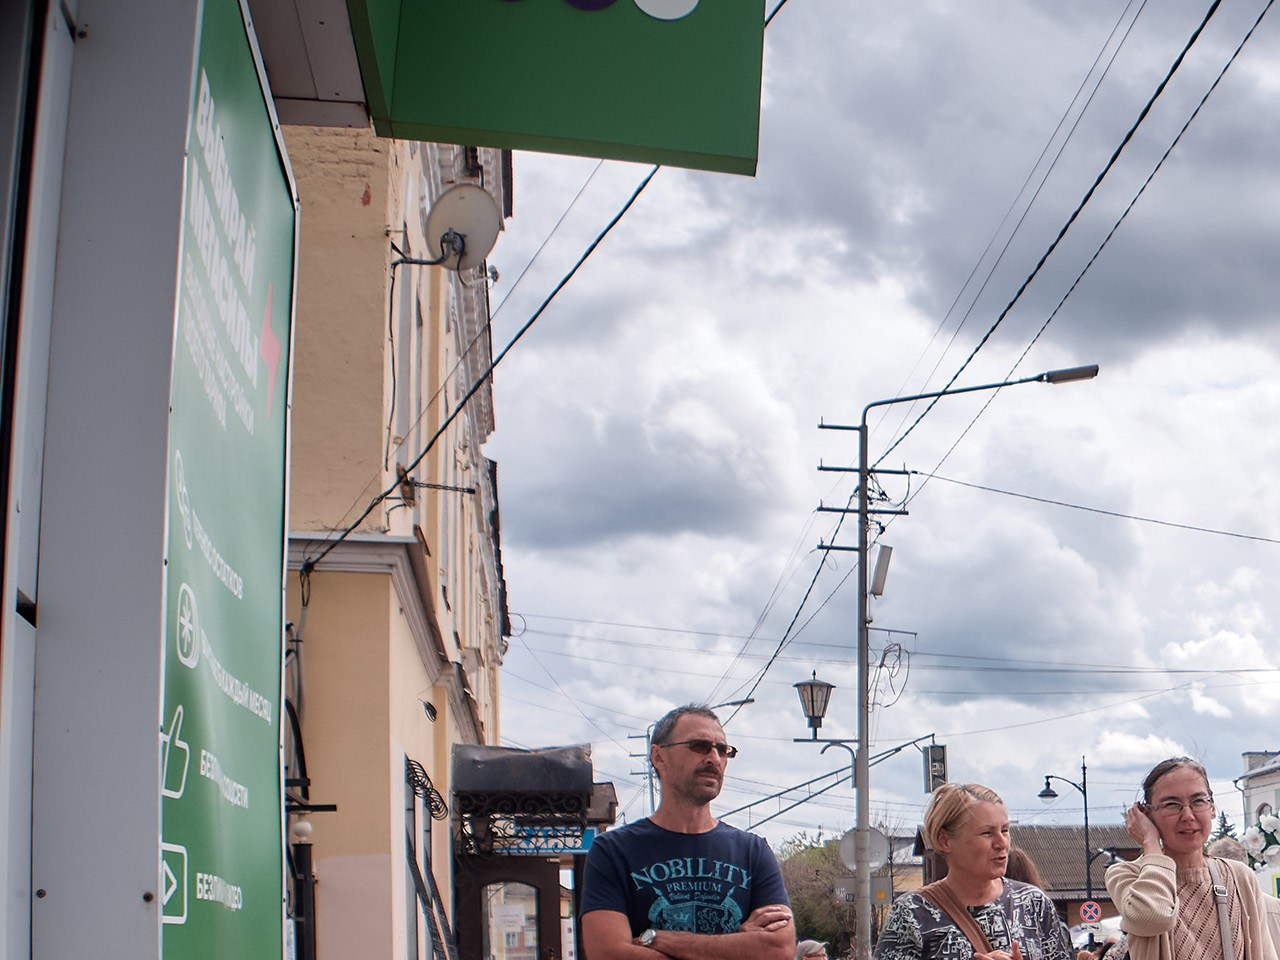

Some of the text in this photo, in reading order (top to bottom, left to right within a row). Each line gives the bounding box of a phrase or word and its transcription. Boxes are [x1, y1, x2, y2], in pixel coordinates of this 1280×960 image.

[196, 66, 256, 294] ВЫБИРАЙ
[189, 156, 259, 390] МЕГАСИЛЫ
[249, 689, 272, 725] МЕСЯЦ
[630, 857, 753, 891] NOBILITY
[666, 881, 722, 894] PREMIUM
